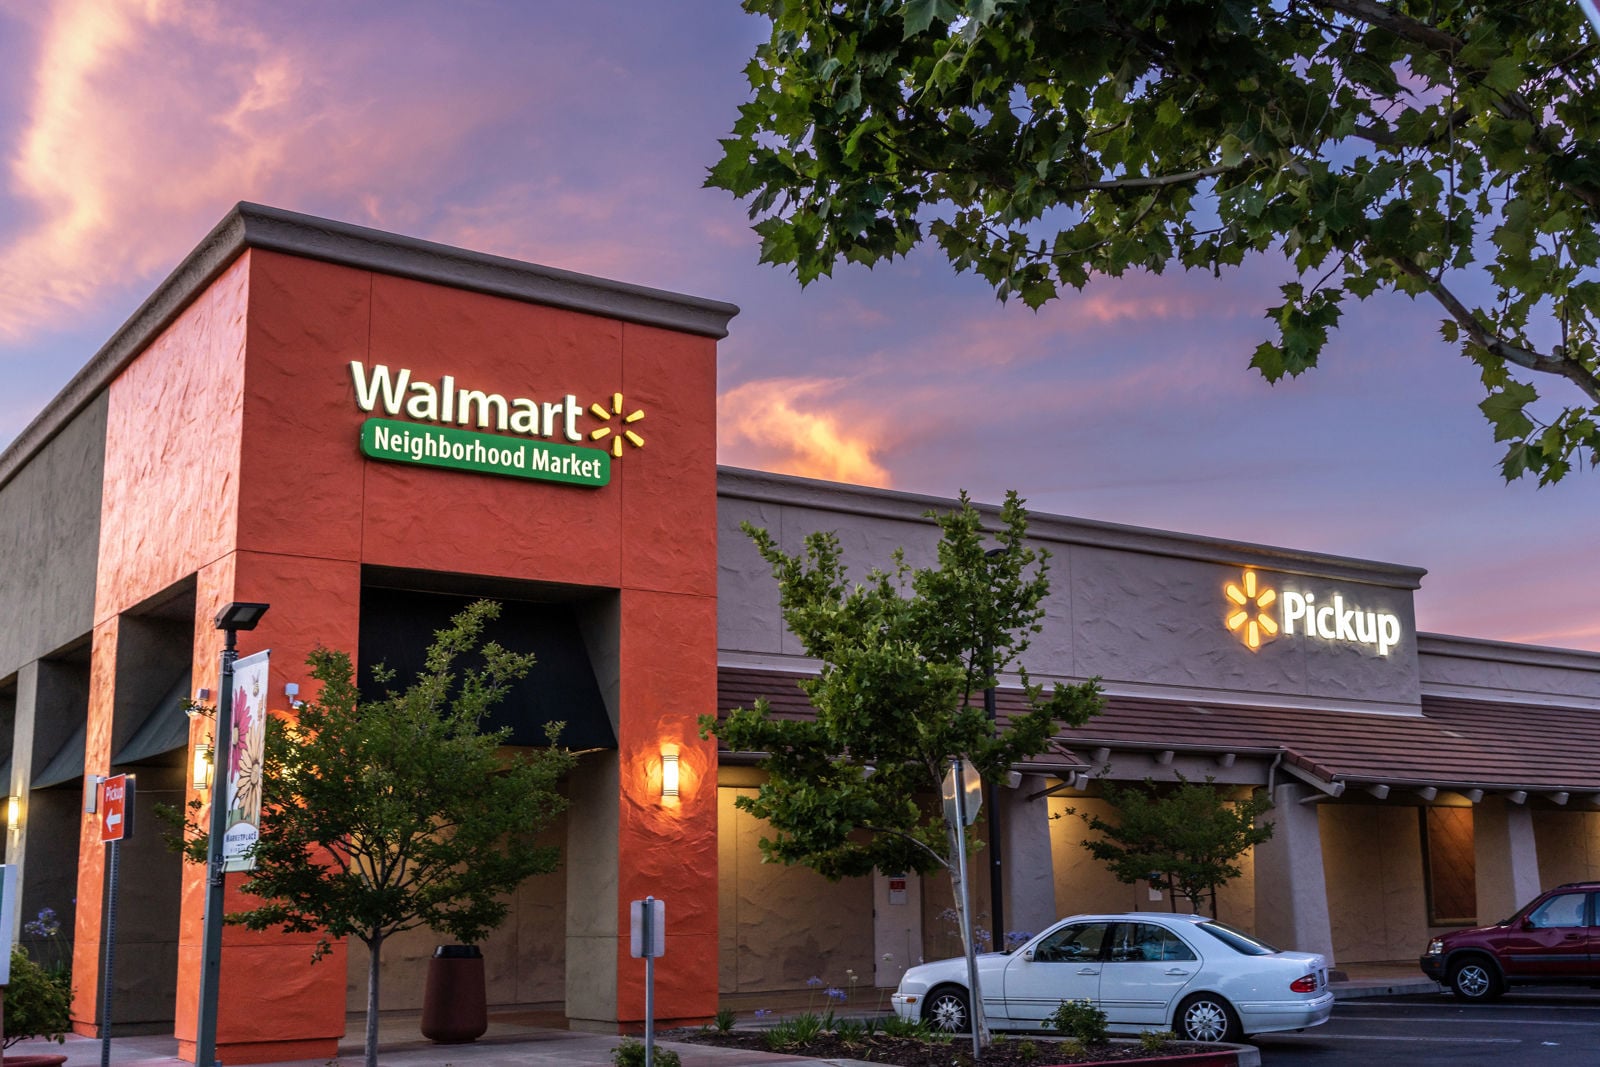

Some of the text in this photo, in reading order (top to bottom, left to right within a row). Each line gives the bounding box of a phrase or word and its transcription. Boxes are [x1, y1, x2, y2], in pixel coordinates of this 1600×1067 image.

[350, 360, 583, 441] Walmart
[374, 426, 601, 479] Neighborhood Market
[1283, 591, 1400, 656] Pickup
[105, 785, 124, 803] Pickup
